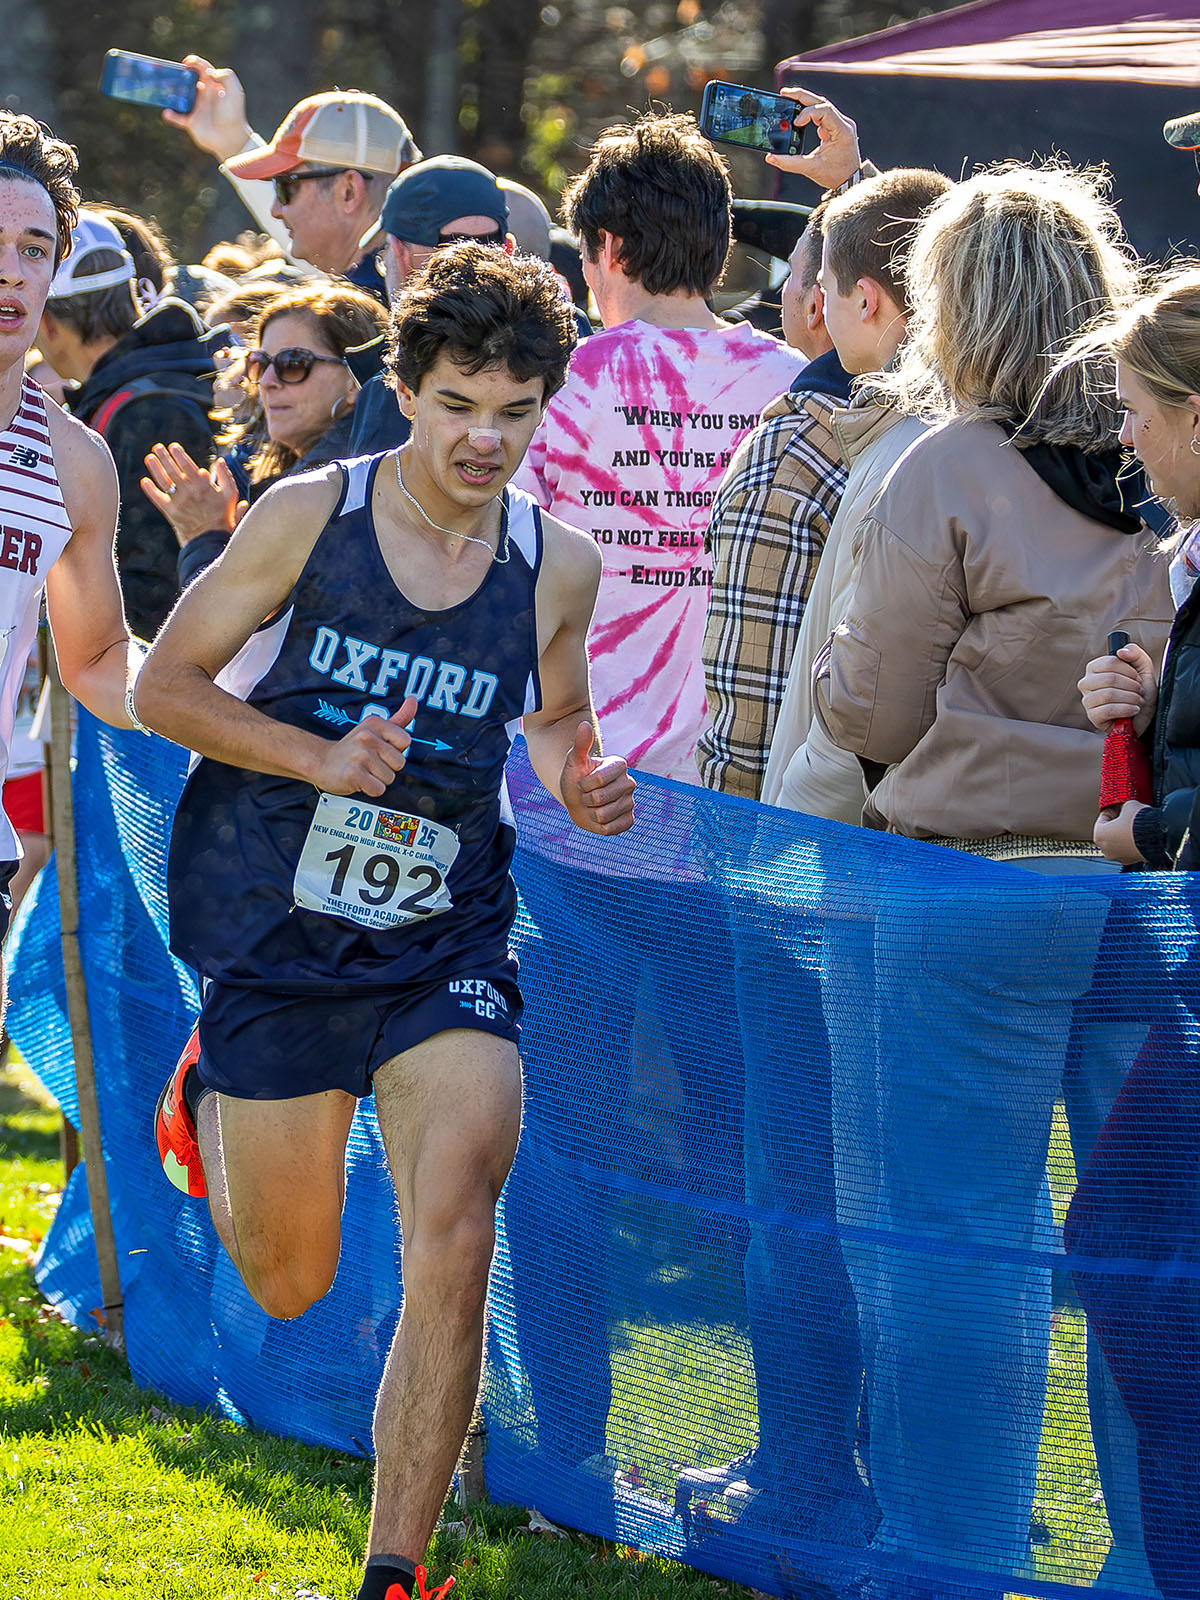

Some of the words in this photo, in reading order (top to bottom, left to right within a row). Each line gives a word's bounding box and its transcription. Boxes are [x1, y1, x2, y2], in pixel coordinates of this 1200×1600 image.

[687, 413, 724, 430] YOU
[612, 450, 651, 467] AND
[656, 448, 716, 468] YOU'RE
[580, 490, 616, 507] YOU
[620, 490, 659, 507] CAN
[592, 528, 613, 545] TO
[617, 529, 654, 546] NOT
[658, 530, 699, 548] FEEL
[630, 564, 685, 588] ELIUD
[308, 625, 500, 720] OXFORD
[344, 806, 374, 831] 20
[312, 824, 329, 834] NEW
[329, 828, 360, 843] ENGLAND
[359, 837, 376, 848] HIGH
[376, 841, 401, 854] SCHOOL
[402, 848, 415, 858] X-C
[324, 843, 443, 916] 192
[326, 896, 371, 917] THETFORD
[448, 979, 509, 1013] OXFORD
[475, 999, 496, 1020] CC
